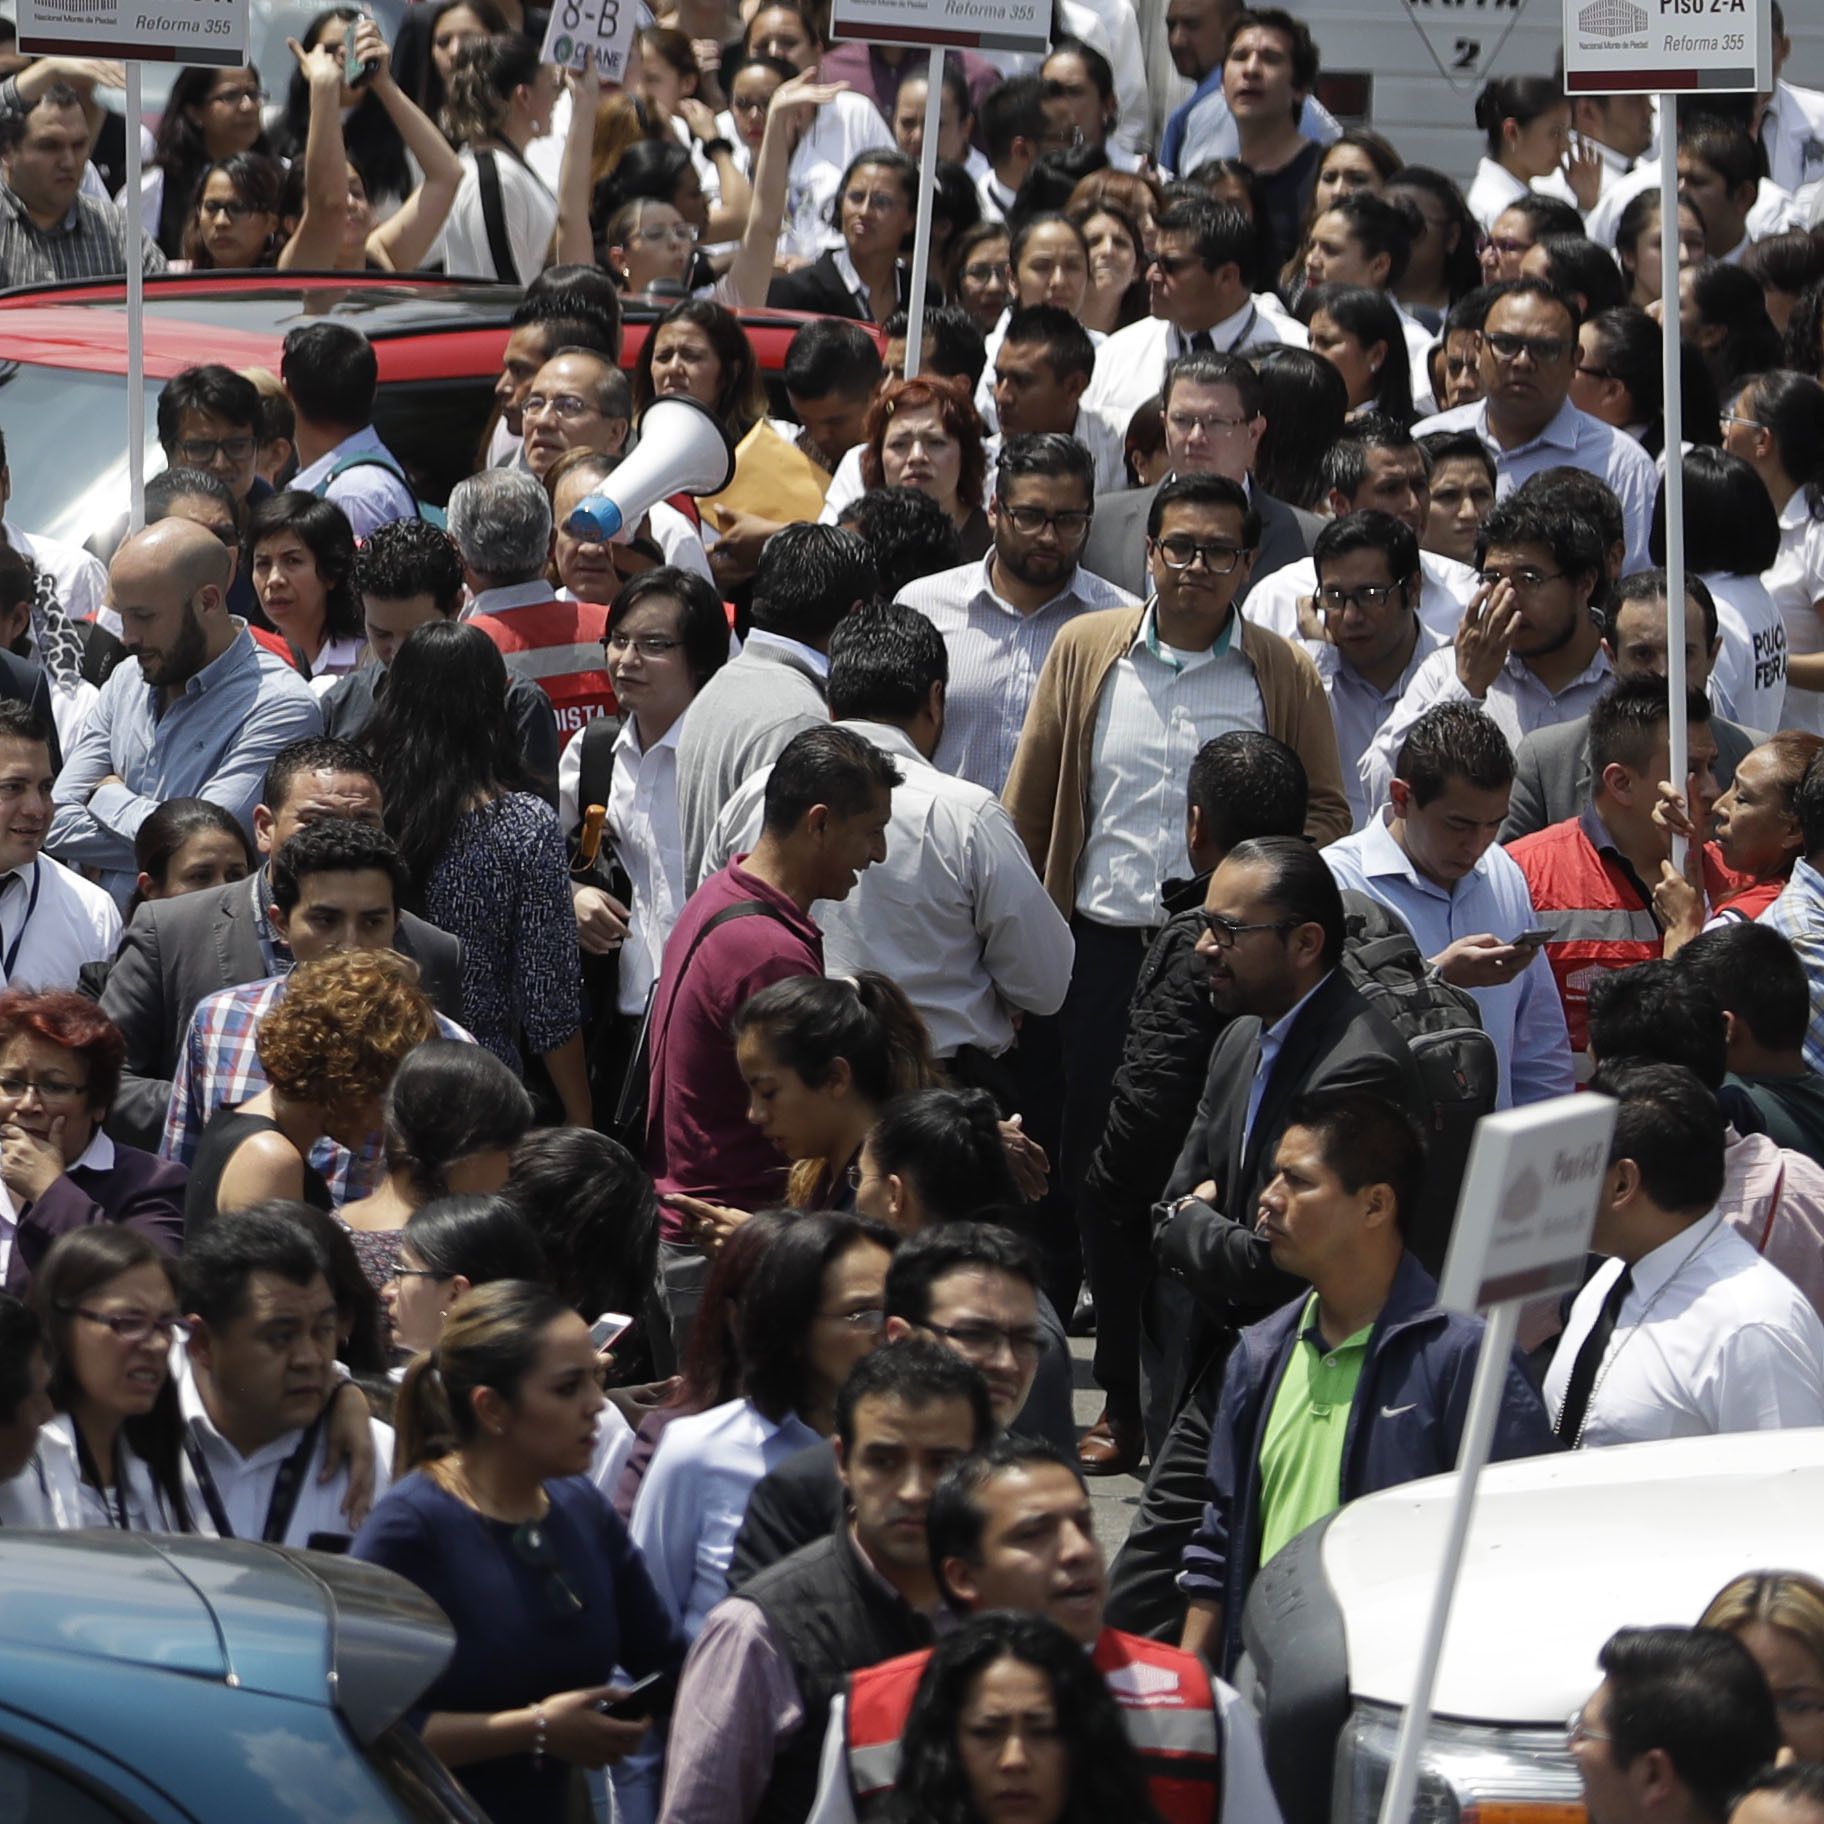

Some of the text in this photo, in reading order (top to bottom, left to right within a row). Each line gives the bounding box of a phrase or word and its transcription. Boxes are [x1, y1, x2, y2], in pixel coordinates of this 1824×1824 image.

[945, 0, 1036, 21] Reforma 355
[136, 15, 232, 35] Reforma 355
[1663, 33, 1745, 52] Reforma 355
[1452, 37, 1481, 69] 2
